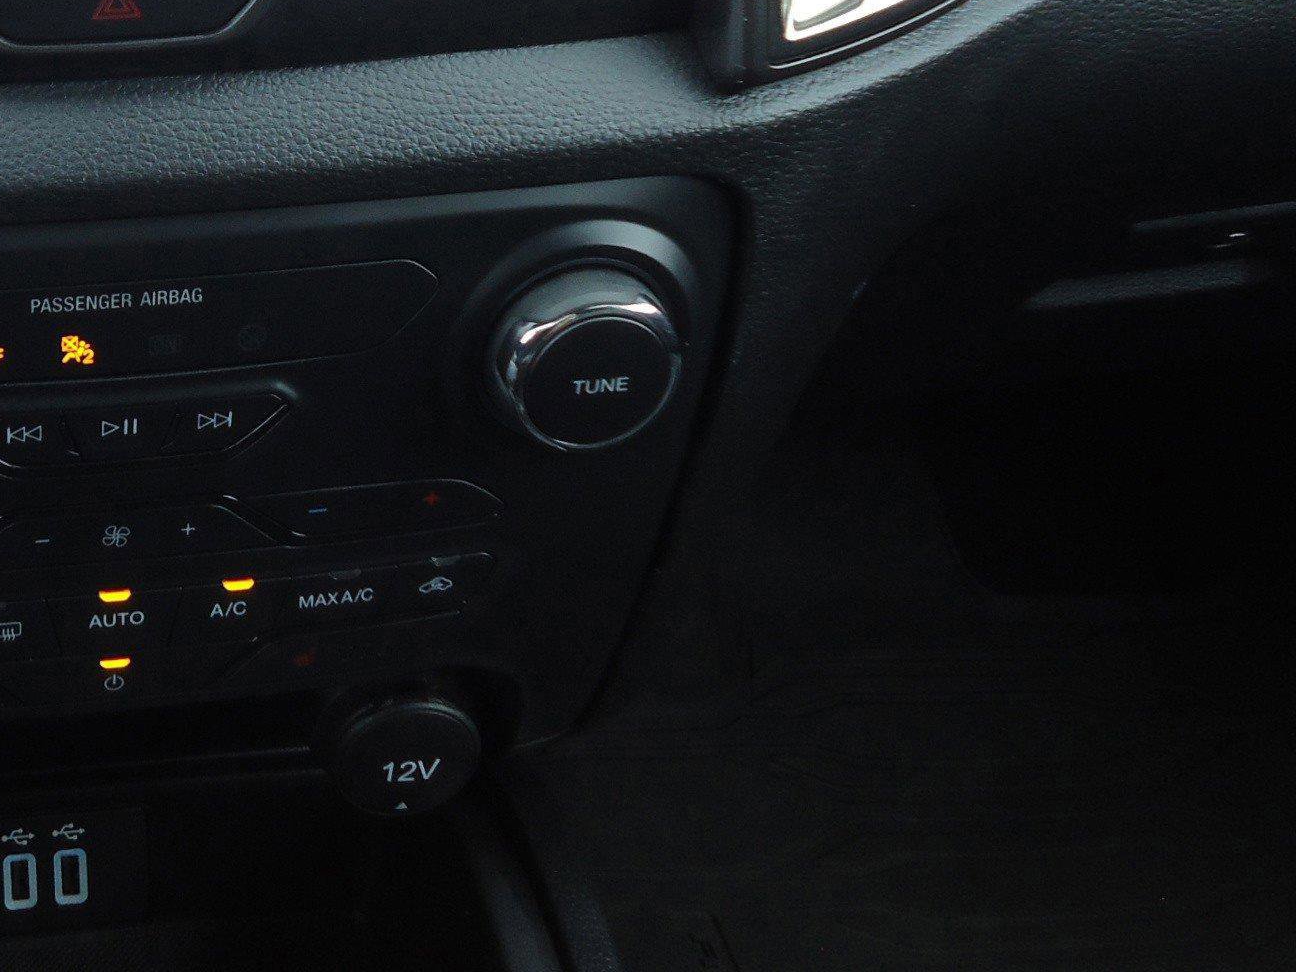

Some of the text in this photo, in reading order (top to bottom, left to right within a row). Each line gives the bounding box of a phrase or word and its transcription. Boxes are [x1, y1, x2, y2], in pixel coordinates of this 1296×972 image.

[30, 287, 204, 315] PASSENGER AIRBAG
[572, 375, 630, 396] TUNE
[210, 600, 248, 619] A/C
[298, 592, 339, 610] MAX
[88, 609, 145, 630] AUTO
[383, 757, 442, 783] 12V
